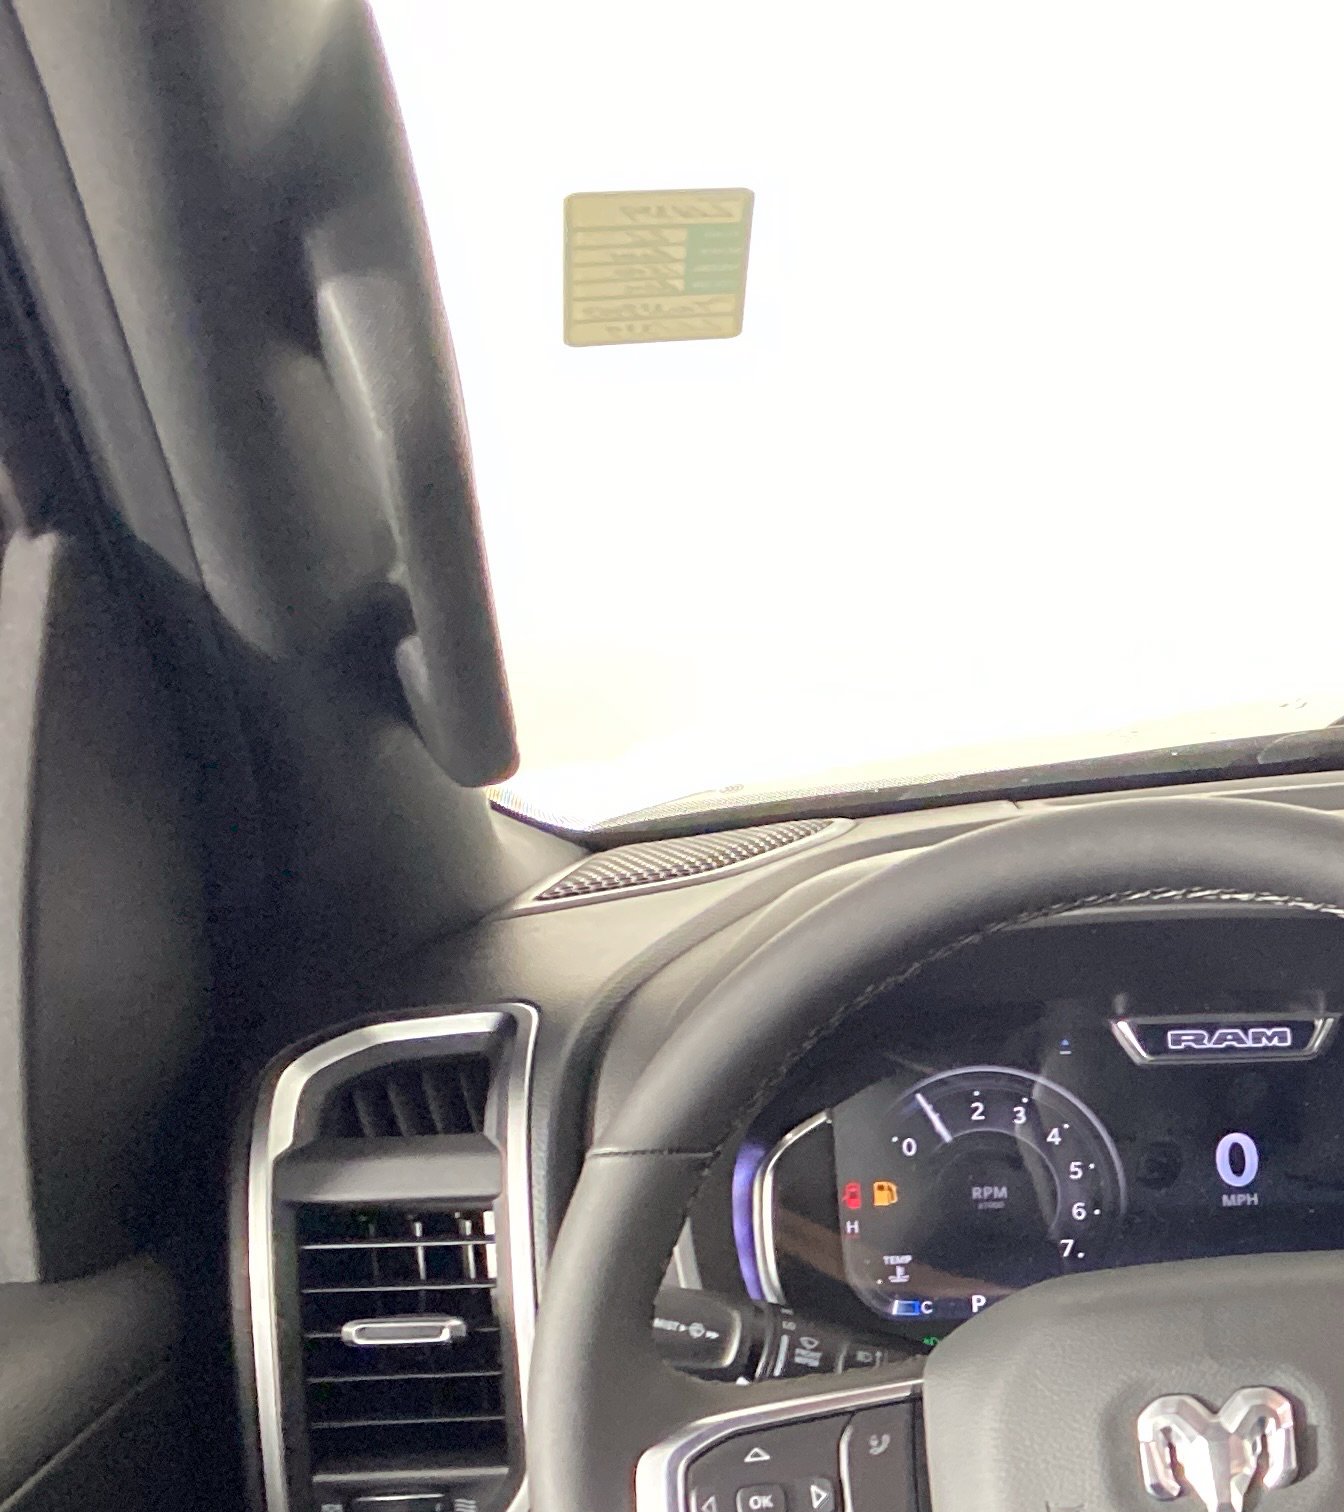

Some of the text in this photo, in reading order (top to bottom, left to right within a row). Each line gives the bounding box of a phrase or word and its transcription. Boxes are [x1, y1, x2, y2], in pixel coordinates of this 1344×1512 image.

[1167, 1028, 1291, 1049] RAM
[971, 1102, 985, 1120] 2
[1013, 1106, 1027, 1124] 3
[1046, 1128, 1061, 1145] 4
[902, 1138, 917, 1157] 0
[1216, 1132, 1259, 1187] 0
[1069, 1161, 1082, 1179] 5
[972, 1186, 1008, 1199] RPM
[1222, 1194, 1258, 1207] MPH
[1072, 1203, 1086, 1221] 6
[846, 1220, 859, 1233] H
[1060, 1240, 1073, 1257] 7
[883, 1255, 912, 1265] TEMP
[921, 1301, 933, 1314] C
[972, 1295, 986, 1312] P
[749, 1495, 773, 1509] OK
